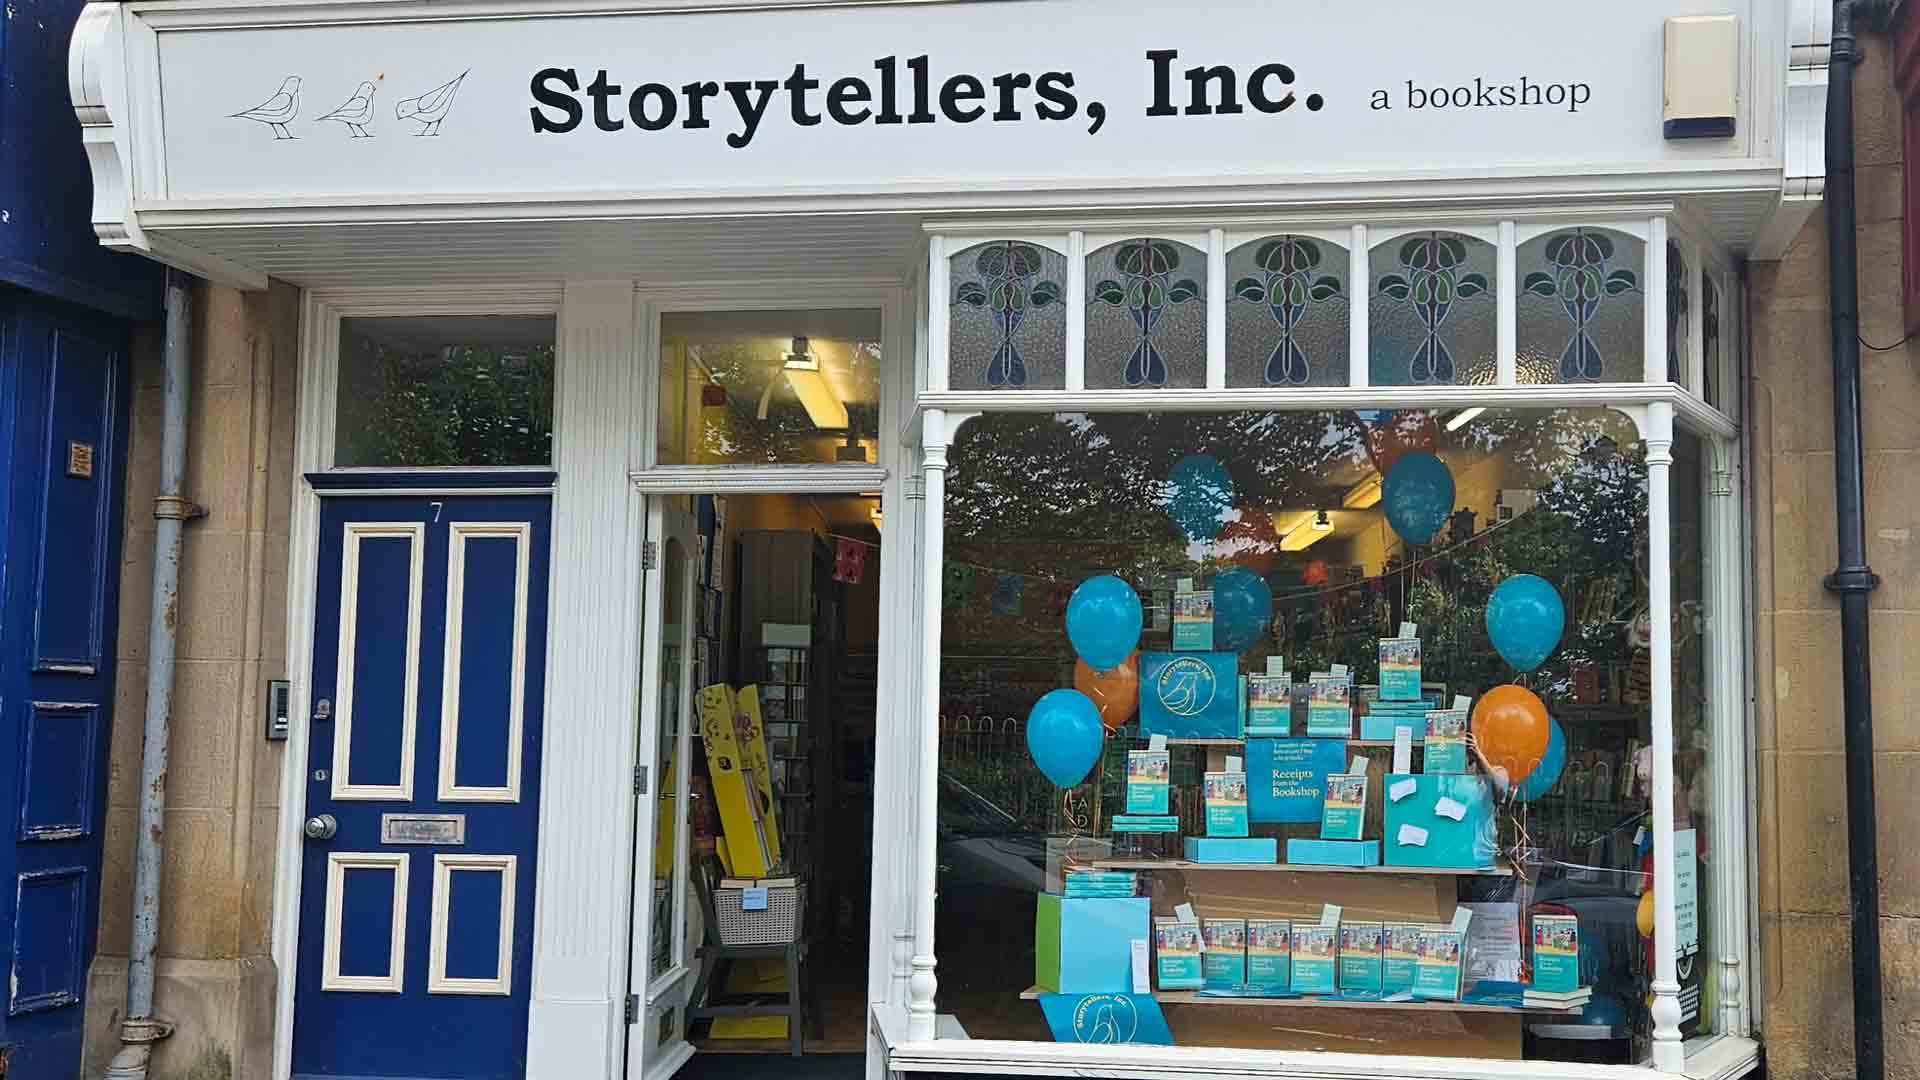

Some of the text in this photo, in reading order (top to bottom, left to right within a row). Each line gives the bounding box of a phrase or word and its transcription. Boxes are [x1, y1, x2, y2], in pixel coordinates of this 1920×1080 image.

[530, 50, 1323, 148] Storytellers, Inc.
[1371, 77, 1591, 112] a bookshop
[430, 502, 443, 523] 7
[1272, 768, 1313, 781] Receipts
[1272, 786, 1320, 798] Bookshop
